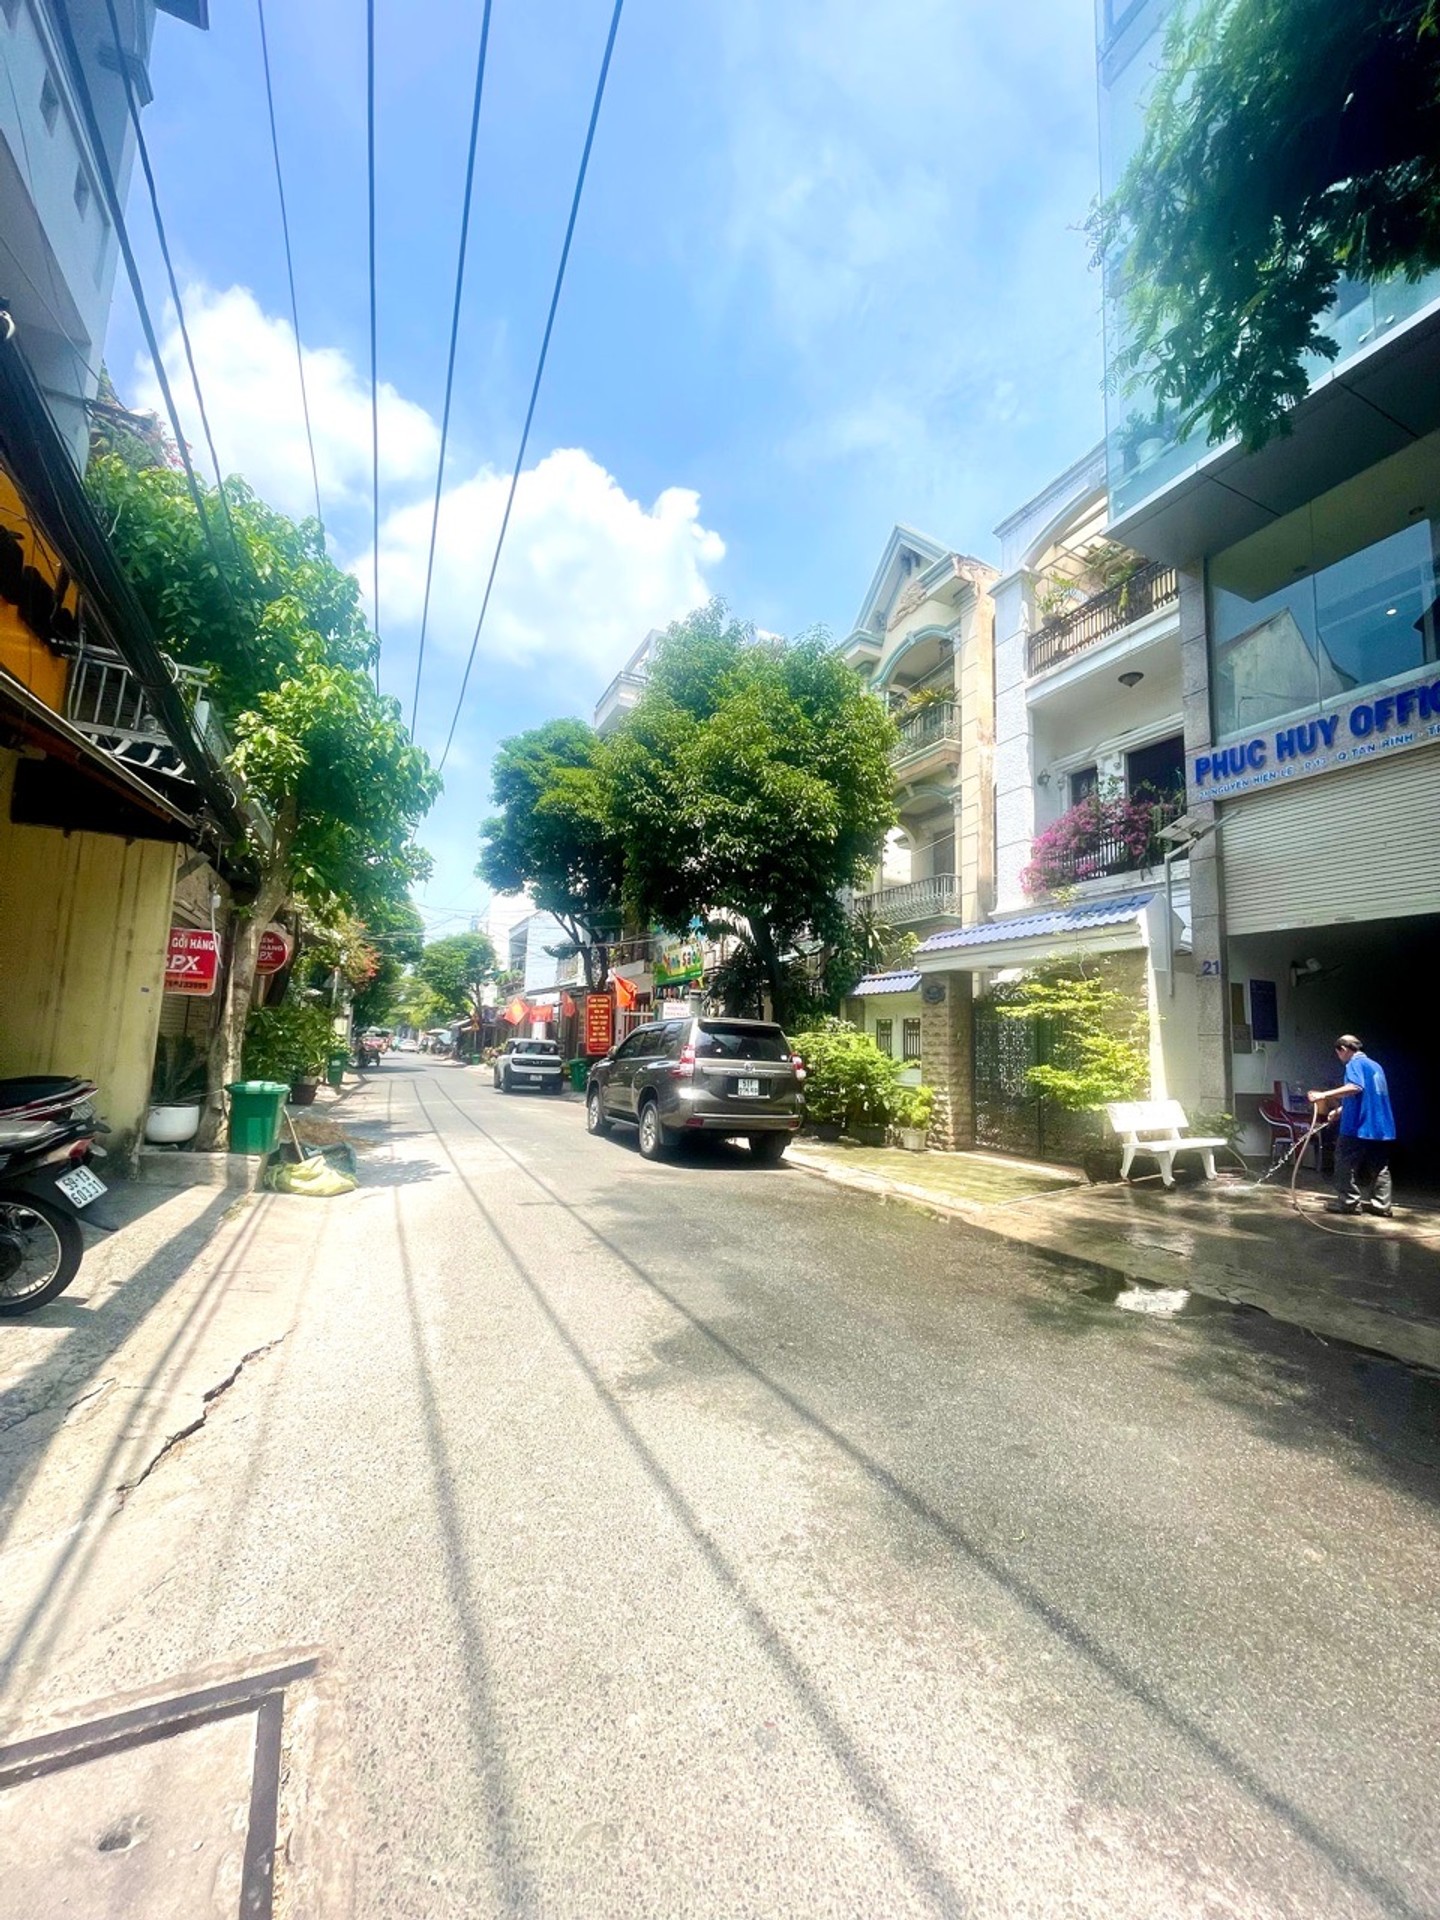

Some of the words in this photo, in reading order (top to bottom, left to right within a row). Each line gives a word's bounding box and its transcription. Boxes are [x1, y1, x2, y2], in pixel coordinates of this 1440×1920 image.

[1195, 739, 1267, 785] PHUC
[1275, 714, 1339, 762] HUY
[1203, 960, 1220, 975] 21
